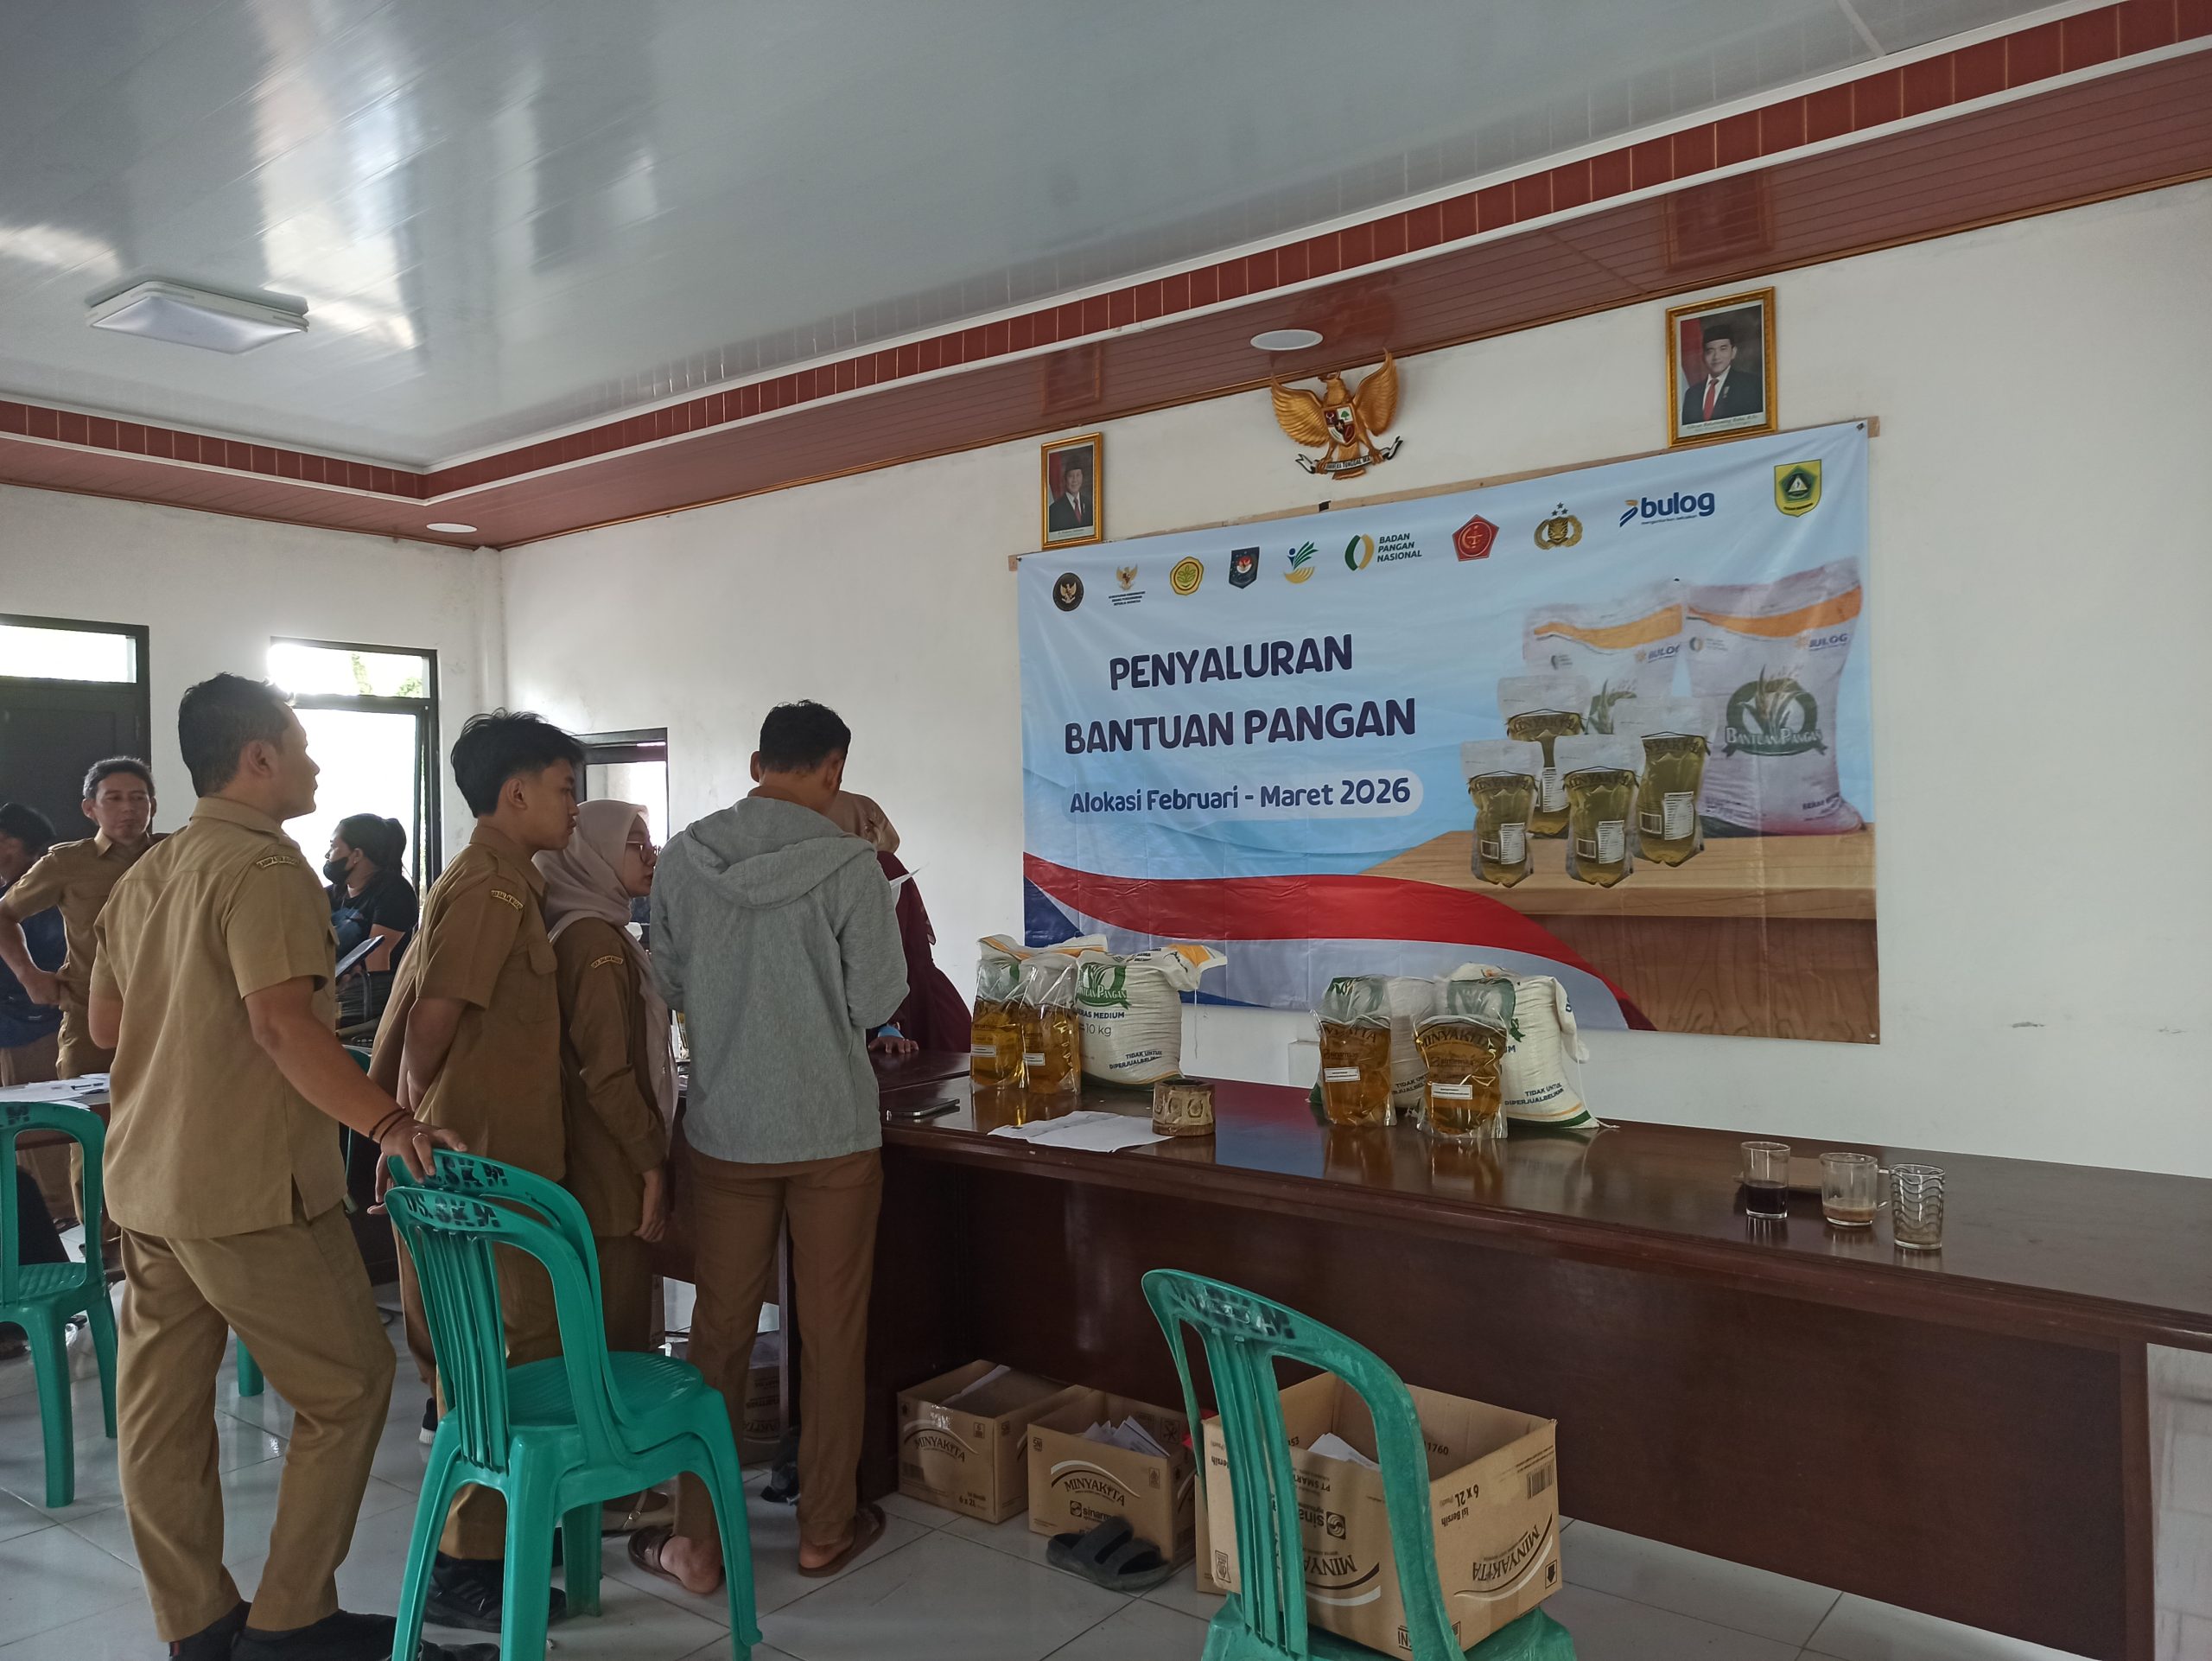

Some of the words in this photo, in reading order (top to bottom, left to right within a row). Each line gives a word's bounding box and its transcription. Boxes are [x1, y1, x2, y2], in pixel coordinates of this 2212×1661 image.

[1641, 492, 1715, 519] bulog
[1379, 532, 1410, 544] BADAN
[1378, 542, 1414, 553] PANGAN
[1377, 550, 1422, 563] NASIONAL
[1109, 633, 1352, 690] PENYALURAN
[1065, 711, 1234, 754] BANTUAN
[1244, 697, 1415, 745] PANGAN
[1071, 788, 1142, 813] Alokasi
[1147, 786, 1238, 811] Februari
[1261, 784, 1333, 808] Maret
[1340, 777, 1411, 805] 2026
[1098, 1024, 1111, 1037] kg
[1525, 1088, 1545, 1097] TIDAK
[1064, 1478, 1126, 1506] MINYAKITA
[1473, 1484, 1479, 1498] 6
[1441, 1511, 1461, 1527] Bersih
[1472, 1524, 1541, 1581] MINYAKITA
